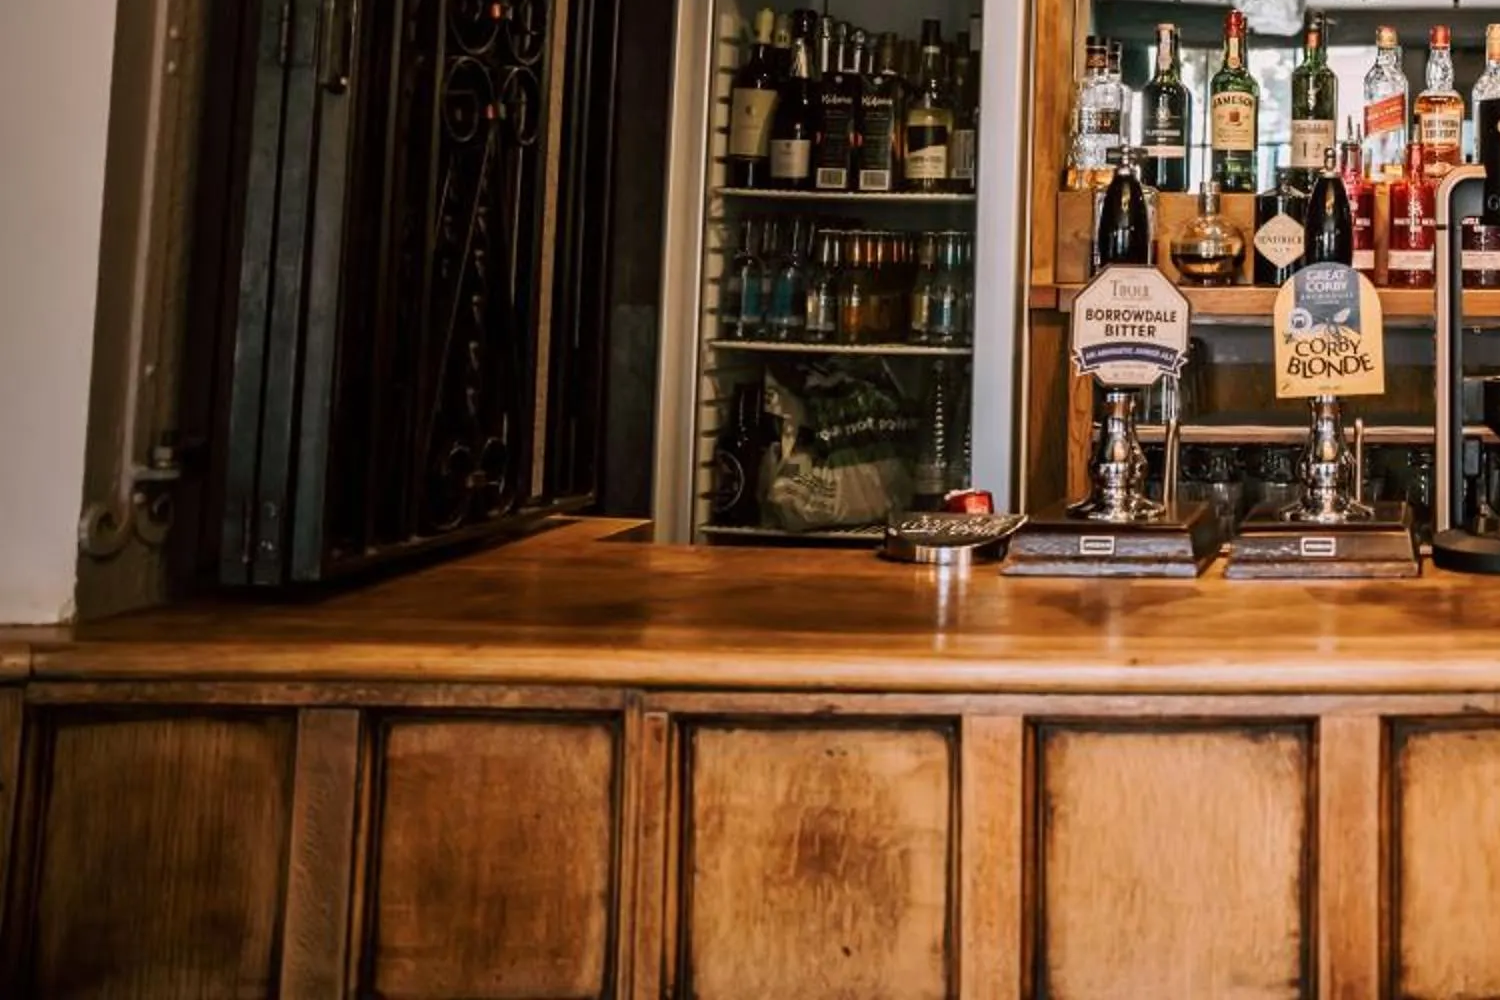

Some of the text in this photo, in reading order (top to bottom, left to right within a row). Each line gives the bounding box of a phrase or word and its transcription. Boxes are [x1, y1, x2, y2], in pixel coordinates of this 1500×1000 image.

[1305, 281, 1348, 293] CORBY
[1085, 308, 1178, 323] BORROWDALE
[1105, 324, 1158, 338] BITTER
[1295, 336, 1362, 357] CORBY
[1287, 353, 1375, 379] BLONDE
